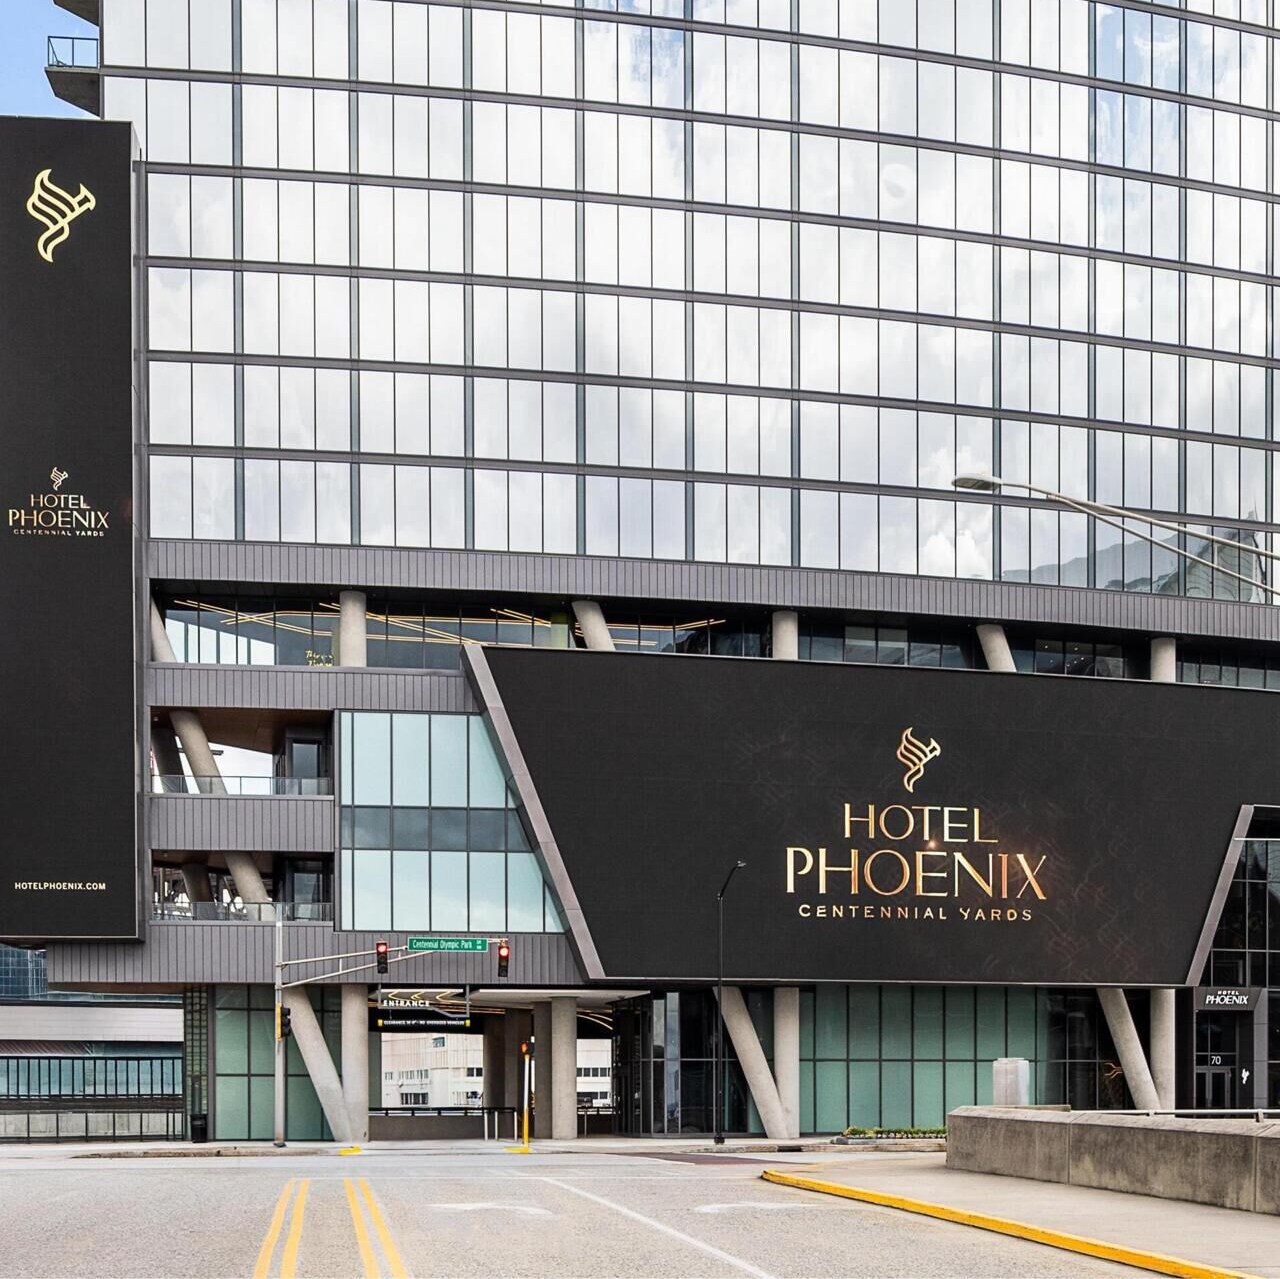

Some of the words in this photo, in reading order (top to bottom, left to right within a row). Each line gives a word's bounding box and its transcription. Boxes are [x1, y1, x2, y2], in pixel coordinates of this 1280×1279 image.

[30, 494, 91, 509] HOTEL
[8, 509, 110, 529] PHOENIX
[844, 803, 999, 843] HOTEL
[786, 847, 1047, 900] PHOENIX
[14, 882, 106, 890] HOTELPHOENIX.COM
[798, 904, 948, 920] CENTENNIAL
[959, 908, 1033, 921] YARDS
[412, 939, 438, 949] Centennial
[461, 940, 472, 949] Park
[1205, 995, 1249, 1005] PHOENIX
[1211, 1056, 1221, 1065] 70
